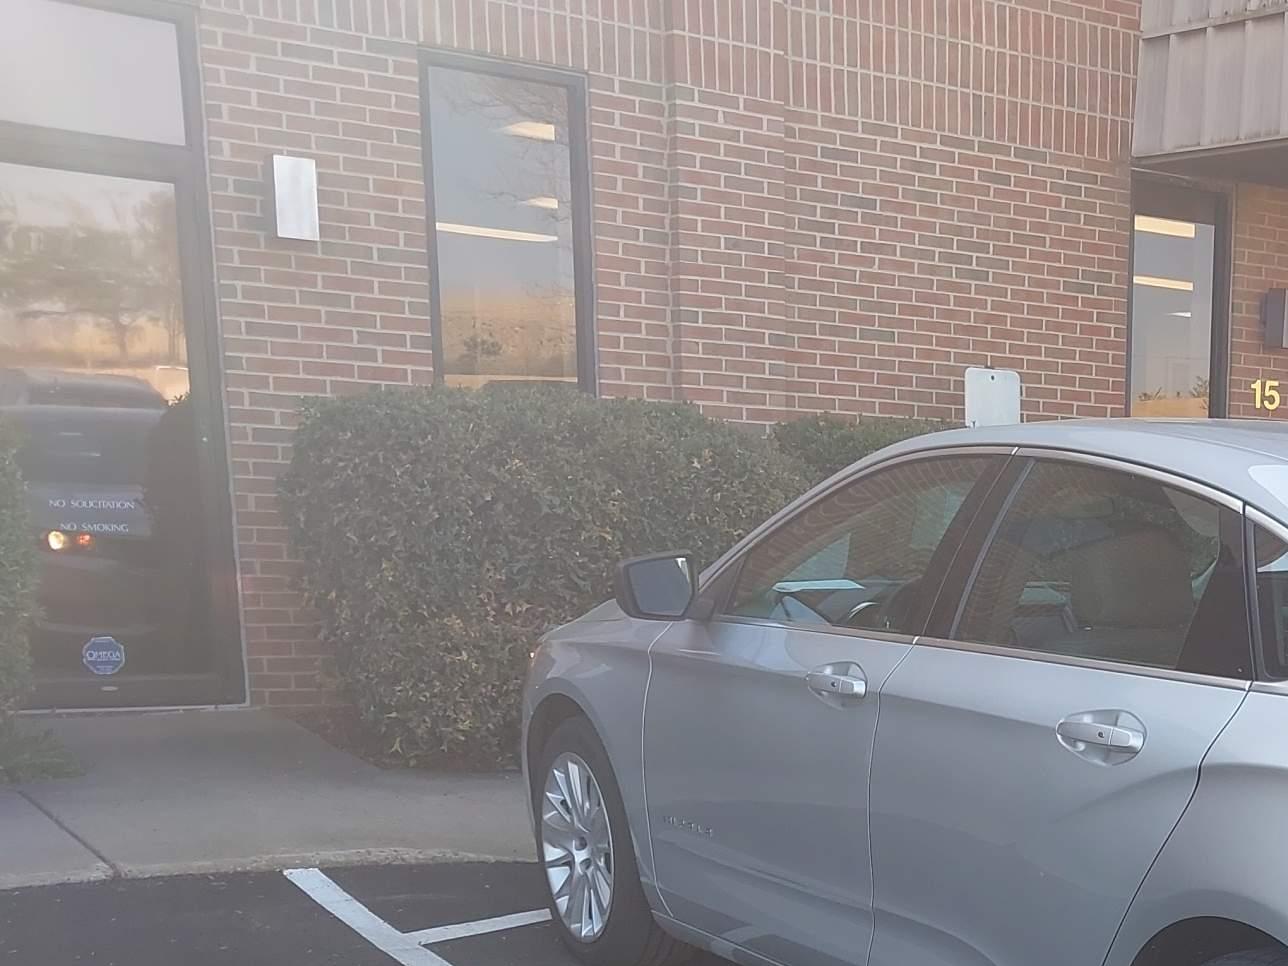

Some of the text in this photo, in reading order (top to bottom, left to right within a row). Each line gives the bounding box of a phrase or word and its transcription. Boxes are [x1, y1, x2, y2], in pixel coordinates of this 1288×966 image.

[1250, 379, 1281, 411] 15
[49, 499, 135, 509] NO SOLICITATION
[60, 522, 129, 532] NO SMOKING
